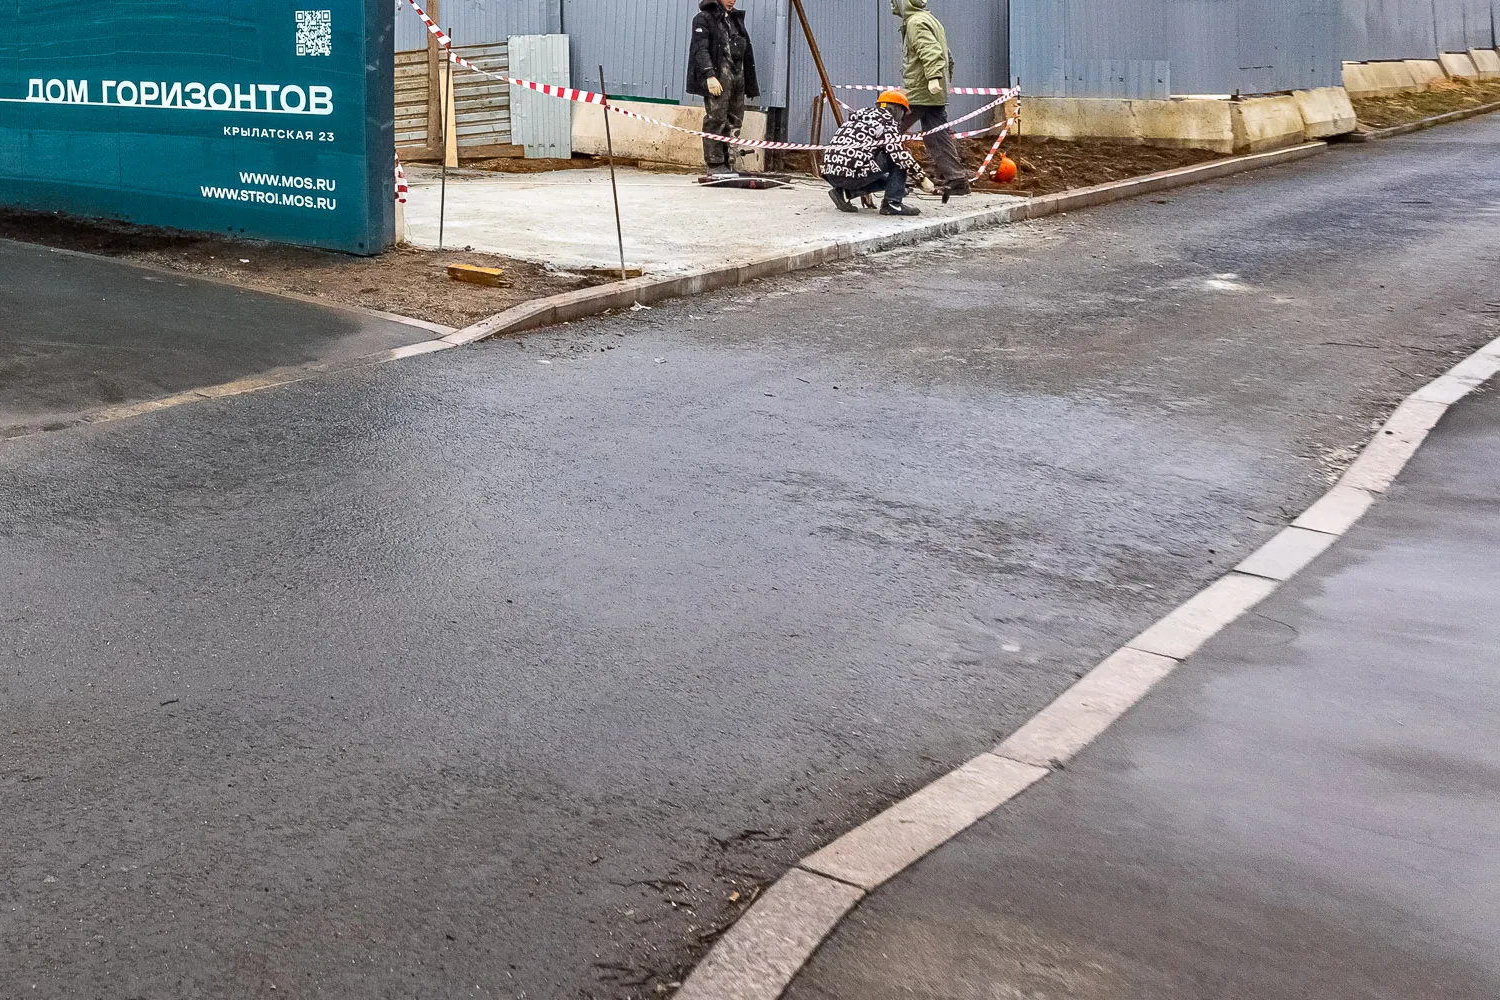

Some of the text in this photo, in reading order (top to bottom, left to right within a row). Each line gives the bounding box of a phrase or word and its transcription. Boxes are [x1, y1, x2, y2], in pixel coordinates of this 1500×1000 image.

[25, 78, 334, 115] ДОМ ГОРИЗОНТОВ
[223, 126, 335, 142] КРЫЛАТСКАЯ 23
[239, 171, 336, 191] WWW.MOS.RU
[200, 186, 336, 211] WWW.STROI.MOS.RU
